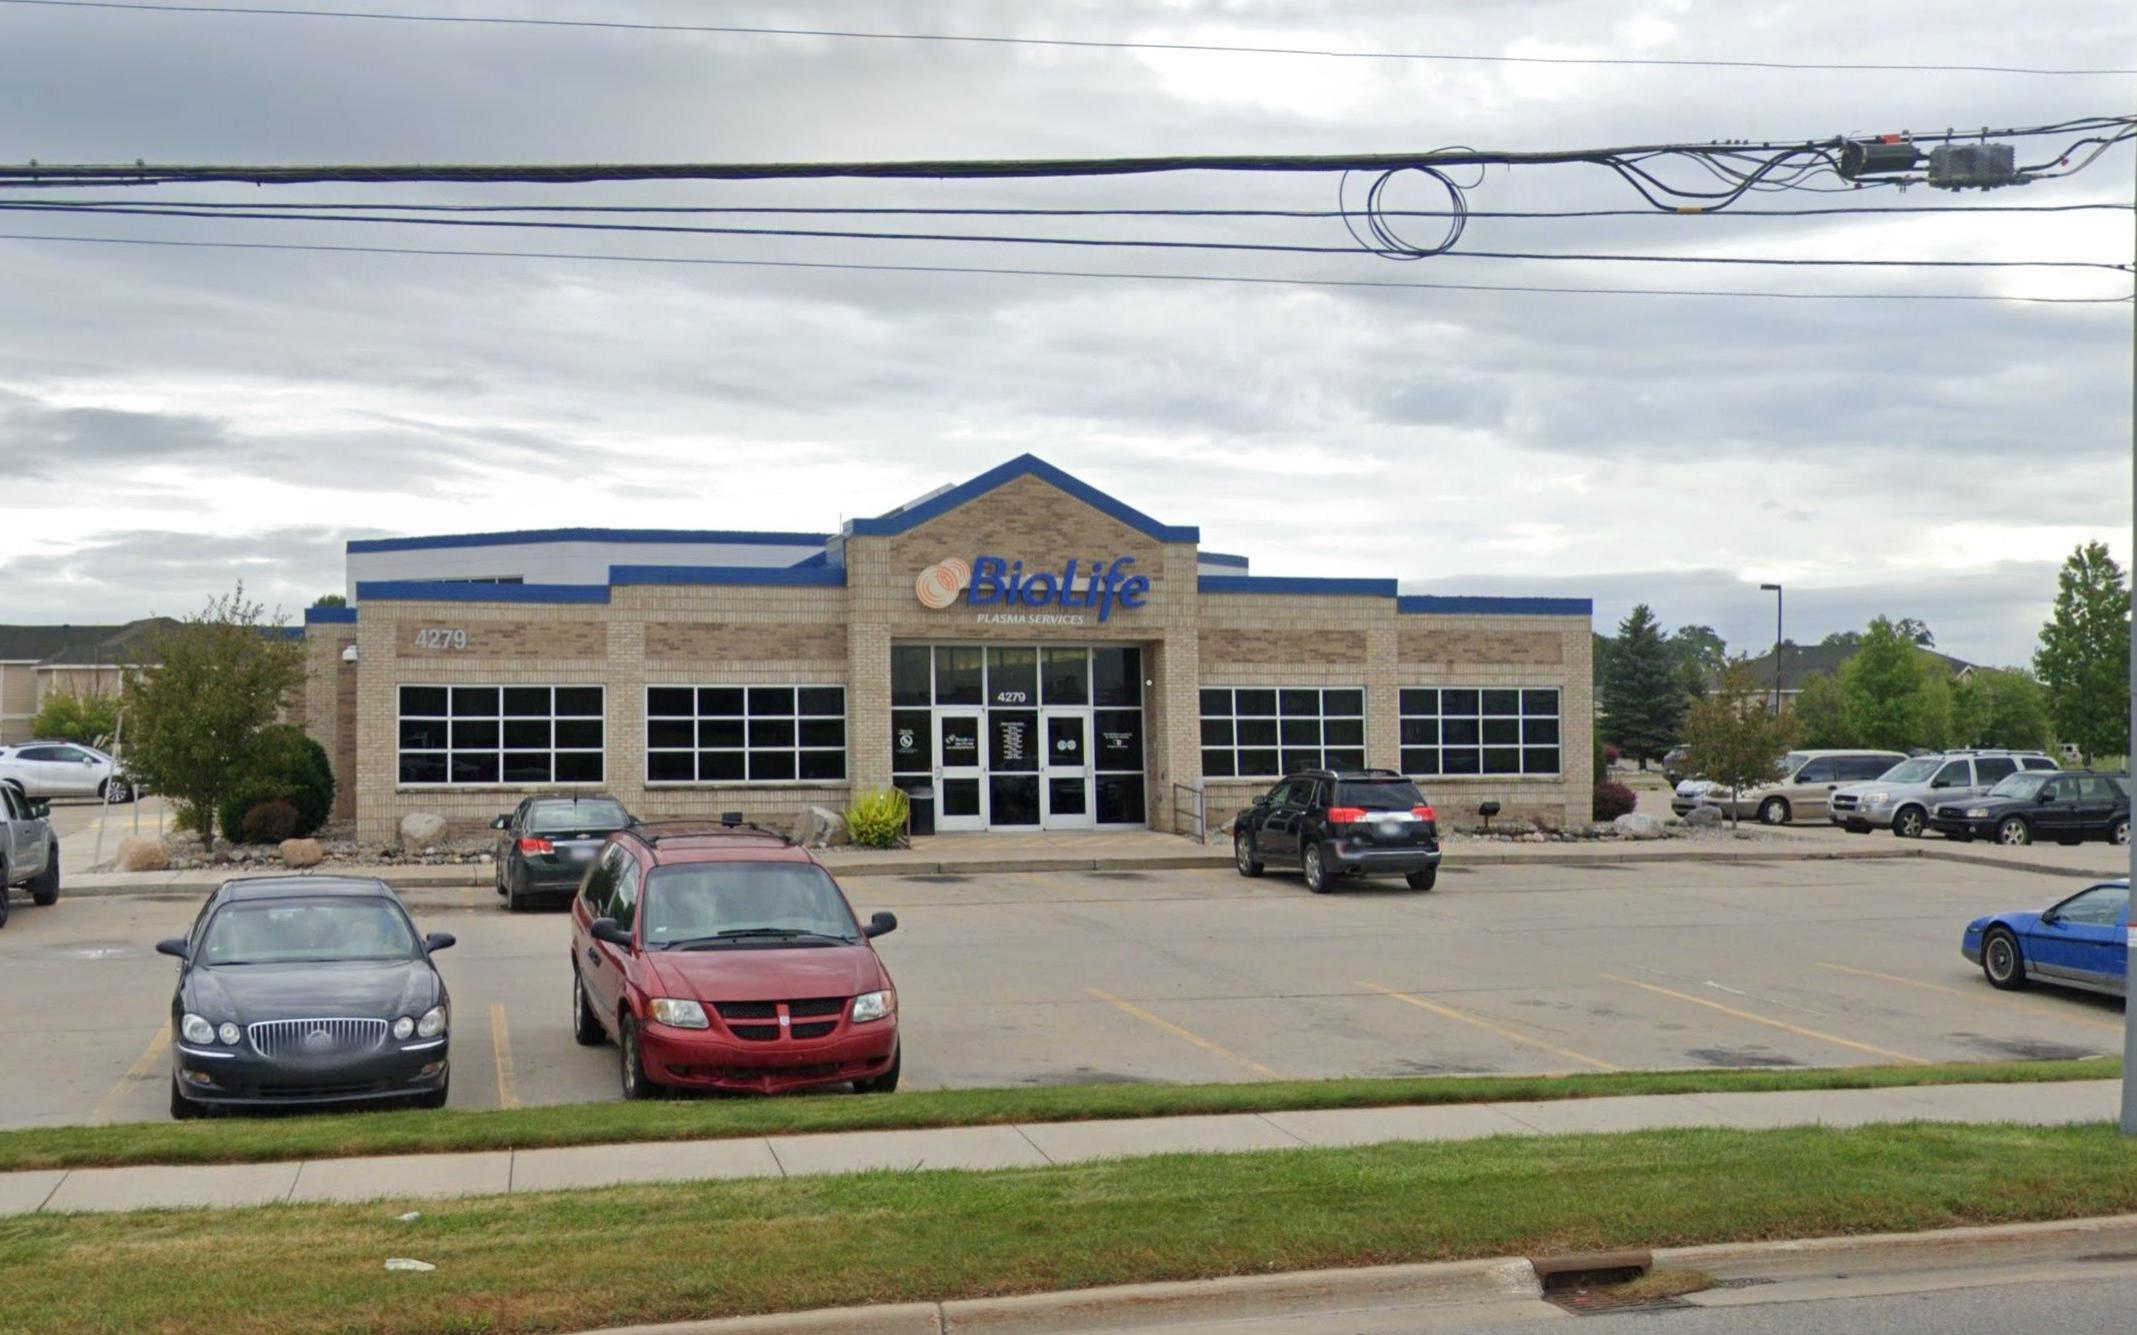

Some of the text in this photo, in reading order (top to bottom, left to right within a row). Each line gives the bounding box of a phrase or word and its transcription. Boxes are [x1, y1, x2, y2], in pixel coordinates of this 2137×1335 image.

[967, 555, 1150, 623] BioLife
[977, 613, 1085, 625] PLASMA SERVICES
[415, 628, 467, 649] 4279
[997, 691, 1026, 703] 4279
